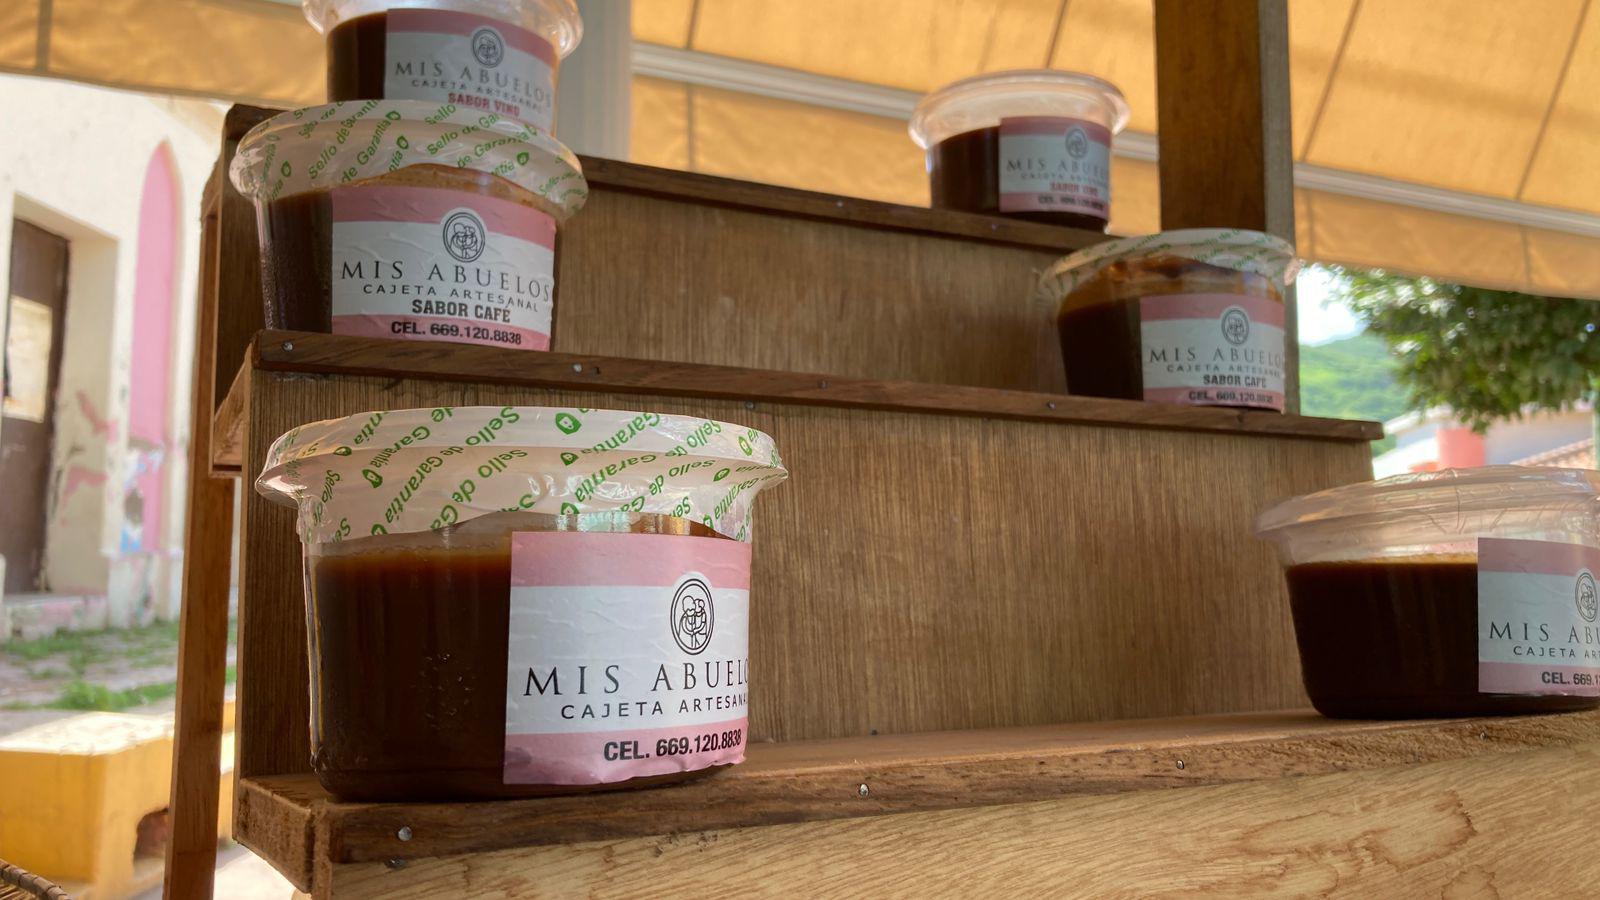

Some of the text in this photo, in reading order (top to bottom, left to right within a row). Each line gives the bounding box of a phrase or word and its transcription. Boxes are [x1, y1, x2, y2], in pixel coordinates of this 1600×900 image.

[395, 61, 442, 77] MIS
[411, 79, 466, 90] CAJETA
[425, 103, 456, 125] Sello
[448, 92, 520, 117] SABOR VINO
[427, 131, 458, 155] Sello
[308, 145, 338, 180] Sello
[341, 260, 550, 303] MIS ABUELOS
[363, 284, 539, 312] CAJETA ARTESANAL
[412, 299, 468, 317] SABOR
[391, 321, 522, 345] CEL. 669.120.8838
[1150, 346, 1196, 364] MIS
[1166, 363, 1219, 374] CAJETA
[1203, 374, 1241, 386] SABOR
[465, 406, 520, 446] Sello
[369, 426, 431, 469] Garantia
[478, 449, 528, 479] Sello
[668, 459, 716, 478] Sello
[321, 469, 341, 504] Sello
[574, 454, 657, 502] Garantia
[648, 474, 665, 497] de
[385, 456, 444, 524] Garantia
[451, 480, 476, 502] de
[1489, 621, 1550, 642] MIS
[1512, 645, 1576, 659] CAJETA
[523, 664, 620, 697] MIS
[1541, 671, 1600, 686] CEL. 669.1
[561, 700, 664, 720] CAJETA
[604, 728, 742, 761] CEL. 669.120.8838
